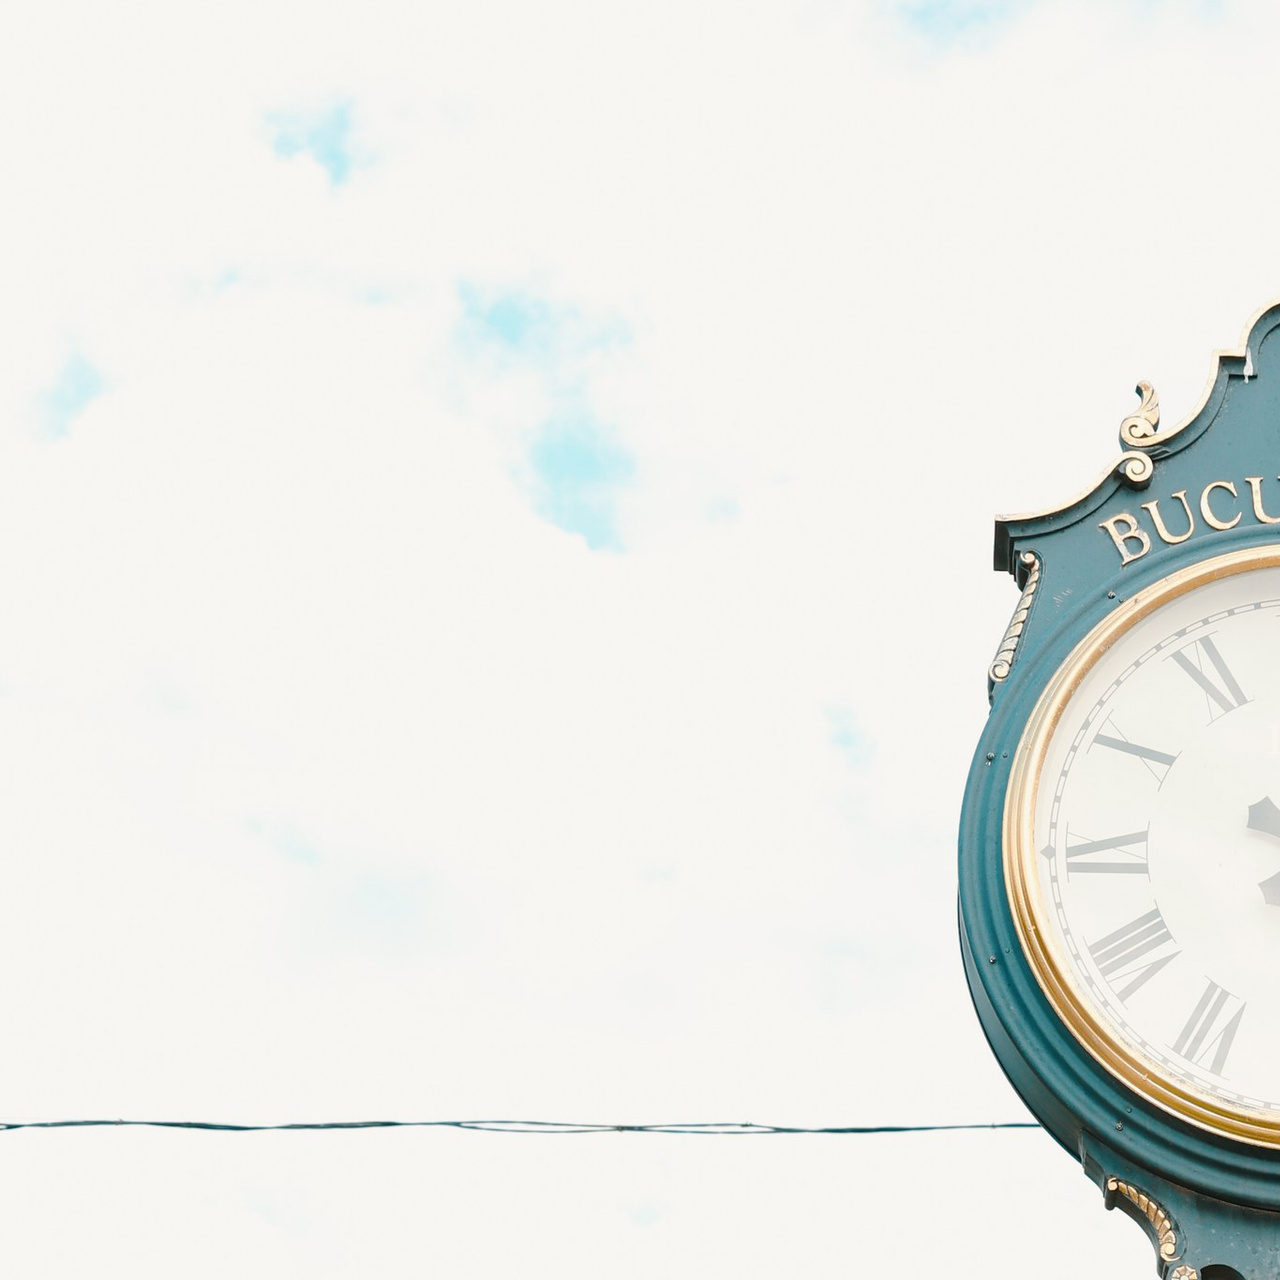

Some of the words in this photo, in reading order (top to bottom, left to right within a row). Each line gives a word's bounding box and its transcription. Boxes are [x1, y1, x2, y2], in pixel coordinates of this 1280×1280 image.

[1162, 630, 1255, 727] XI
[1086, 709, 1183, 792] X
[1066, 821, 1150, 883] IX
[1083, 899, 1182, 1009] VIII
[1165, 975, 1247, 1080] VII
